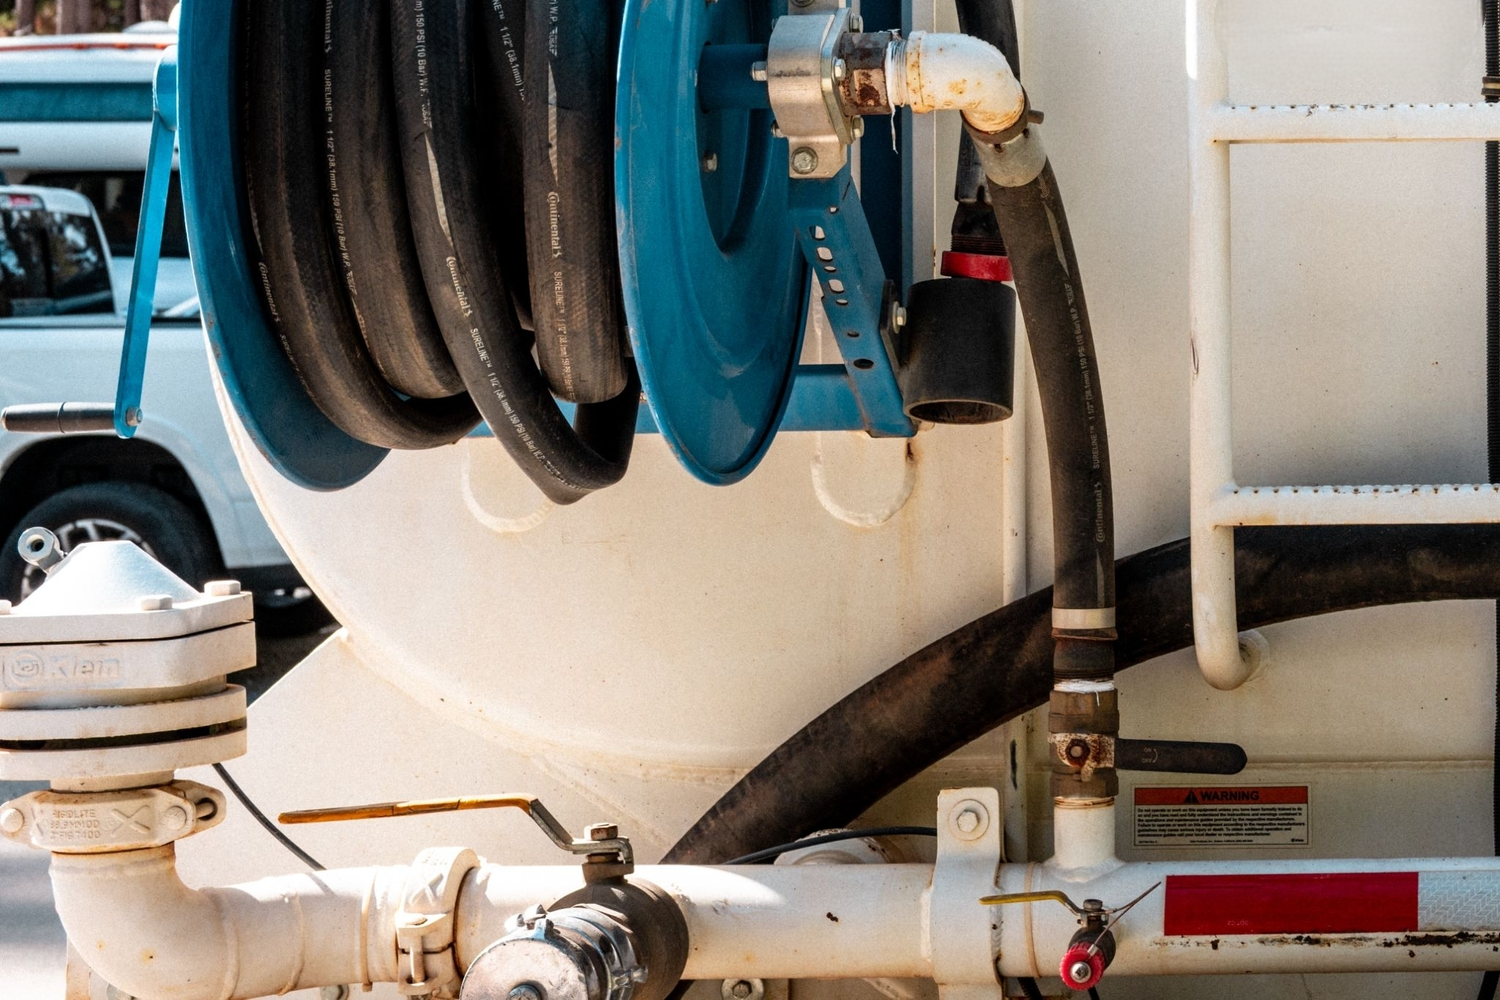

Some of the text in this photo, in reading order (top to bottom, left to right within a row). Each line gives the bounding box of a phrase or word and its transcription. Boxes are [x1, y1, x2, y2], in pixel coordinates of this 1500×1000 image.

[416, 13, 425, 27] 150
[417, 29, 425, 42] PSI
[334, 208, 343, 220] PSI
[547, 191, 561, 252] Continental
[446, 256, 470, 310] Continental
[470, 328, 492, 368] SURELINE™
[514, 421, 525, 434] PSI
[1095, 490, 1106, 543] Continental
[48, 655, 120, 677] Klein
[1201, 790, 1259, 801] WARNING
